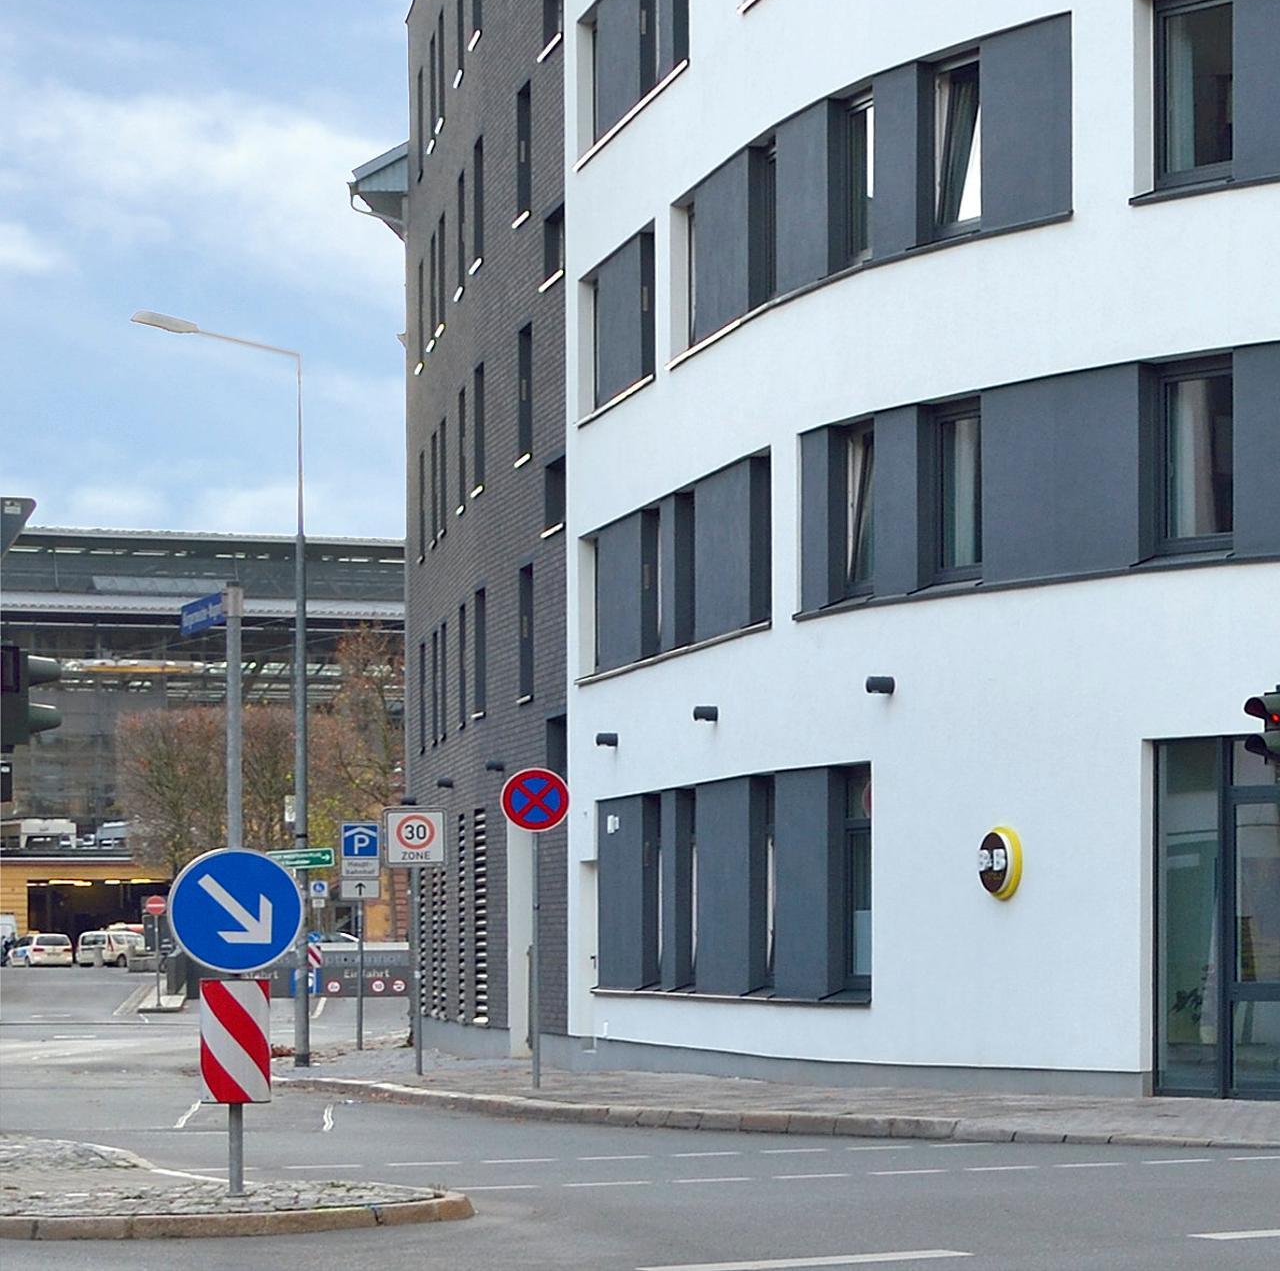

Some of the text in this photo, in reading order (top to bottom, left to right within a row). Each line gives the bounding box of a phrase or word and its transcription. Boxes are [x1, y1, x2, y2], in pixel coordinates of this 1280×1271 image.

[404, 824, 427, 840] 30
[354, 834, 370, 855] P
[401, 851, 431, 861] ZONE
